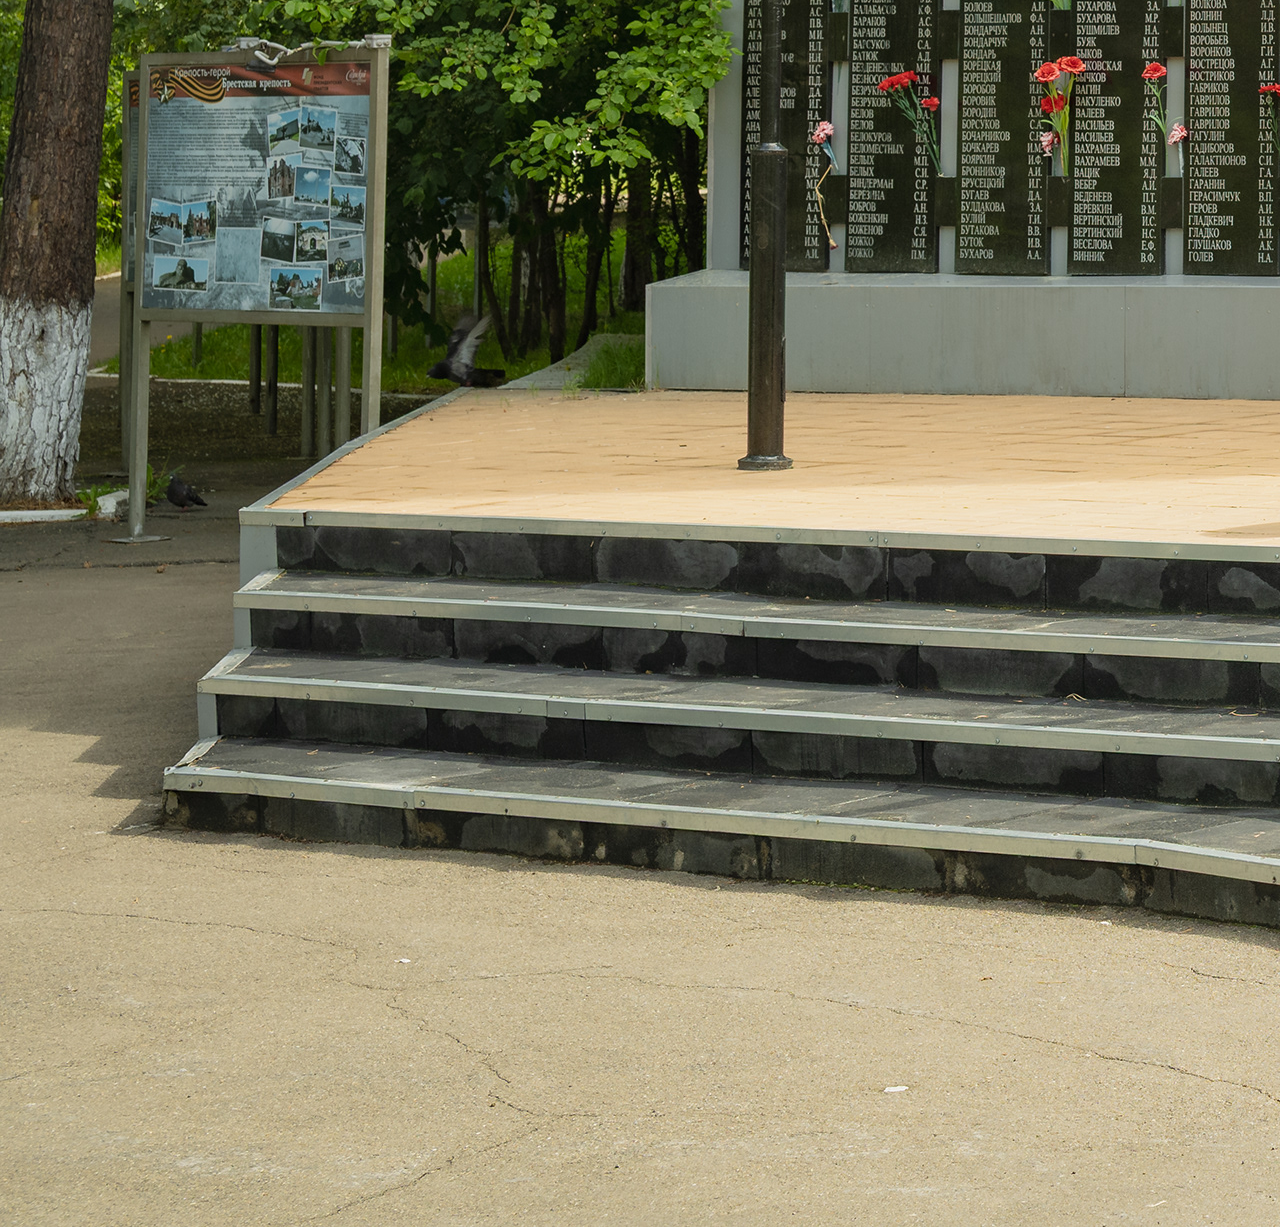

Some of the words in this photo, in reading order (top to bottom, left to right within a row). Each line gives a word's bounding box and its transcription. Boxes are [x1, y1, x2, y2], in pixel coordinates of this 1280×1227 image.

[1076, 1, 1117, 11] БУХАРОВА
[1146, 1, 1161, 11] З.А.
[1076, 25, 1121, 35] БУШМИЛЕВ
[1144, 25, 1160, 35] Н.А.
[174, 67, 231, 80] Крепость-герой
[1189, 71, 1236, 81] ВОСТРИКОВ
[1258, 71, 1276, 81] М.И.
[222, 77, 257, 91] Брестская
[259, 78, 291, 91] крепость
[849, 178, 894, 189] БИНДЕРМАН
[914, 179, 929, 189] С.Р.
[848, 213, 889, 223] БОЖЕНКИН
[914, 215, 929, 225] Н.З.
[848, 224, 884, 235] БОЖЕНОВ
[913, 226, 928, 236] С.Я.
[960, 225, 1000, 235] БУТАКОВА
[1027, 226, 1042, 236] В.В.
[959, 237, 985, 247] БУТОК
[1027, 238, 1043, 248] И.В.
[1072, 239, 1114, 249] ВЕСЕЛОВА
[1141, 240, 1157, 250] Е.Ф.
[959, 249, 994, 259] БУХАРОВ
[1026, 250, 1042, 260] А.А.
[1073, 251, 1106, 261] ВИННИК
[1140, 252, 1156, 263] В.Ф.
[1188, 251, 1214, 262] ГОЛЕВ
[1257, 253, 1274, 263] Н.А.
